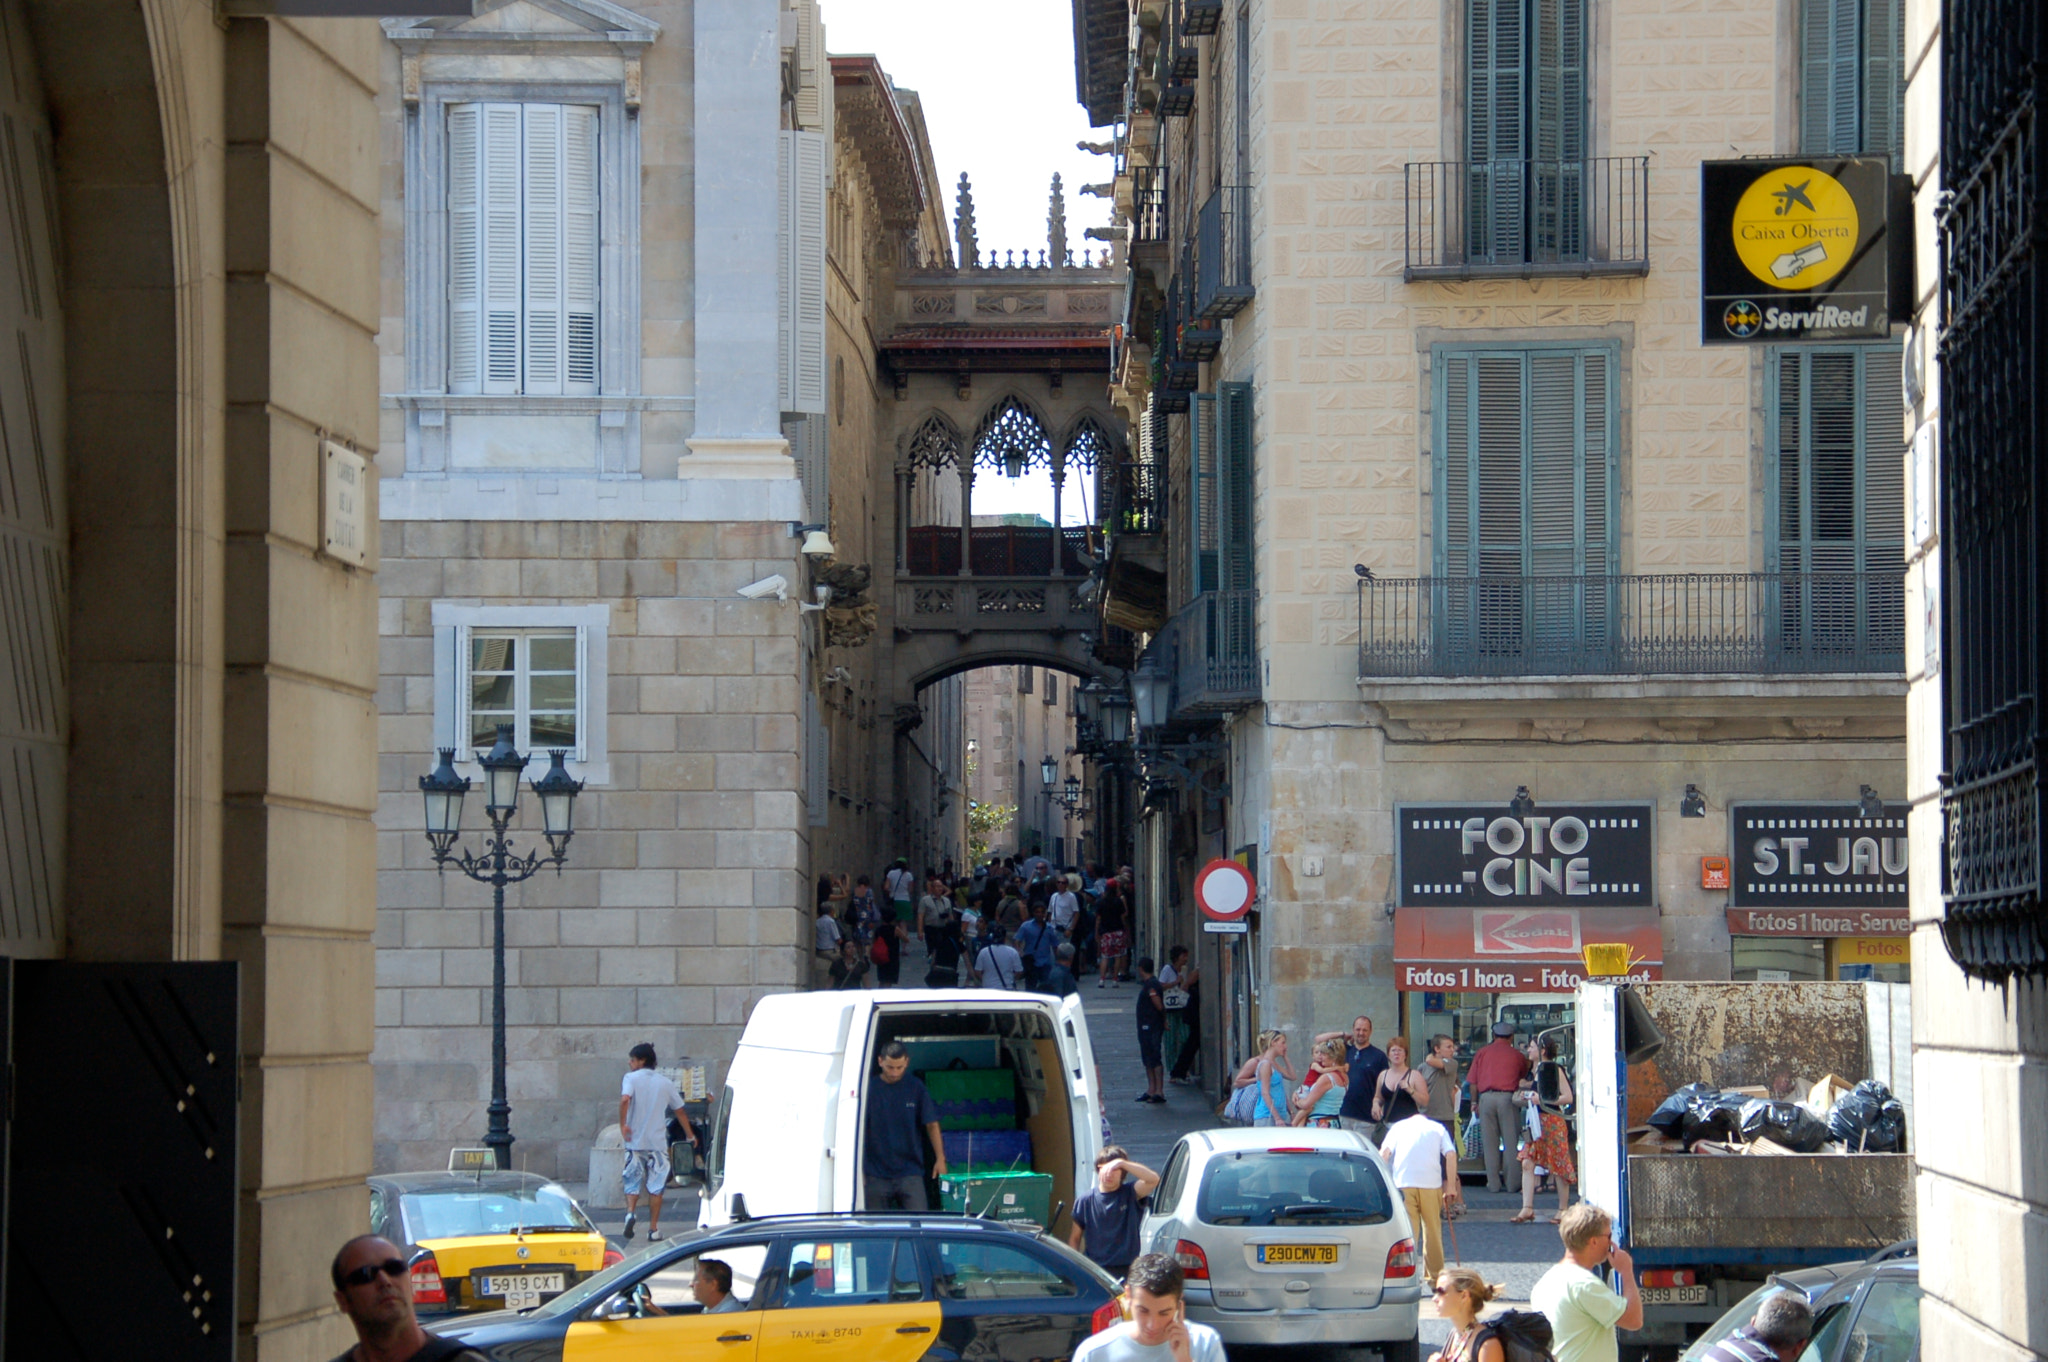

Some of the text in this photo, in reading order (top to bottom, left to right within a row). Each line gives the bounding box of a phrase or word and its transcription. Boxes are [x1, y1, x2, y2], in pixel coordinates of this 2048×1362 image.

[1740, 223, 1850, 241] Caixa Oberta
[1763, 304, 1868, 330] ServiRed
[1462, 816, 1589, 855] FOTO
[1753, 837, 1816, 876] ST.
[1748, 911, 1798, 931] Fotos
[1798, 912, 1807, 931] 1
[1502, 925, 1571, 939] Kodak
[1857, 941, 1903, 956] Fotos
[1406, 966, 1456, 987] Fotos
[1459, 967, 1468, 988] 1
[1474, 968, 1517, 988] hora
[1541, 967, 1581, 988] Foto
[1268, 1247, 1333, 1260] 290 CMV 78
[492, 1275, 560, 1292] 5919 CXT
[509, 1292, 535, 1306] SP
[1679, 1287, 1705, 1301] BDF
[791, 1327, 862, 1339] TAXI 8740
